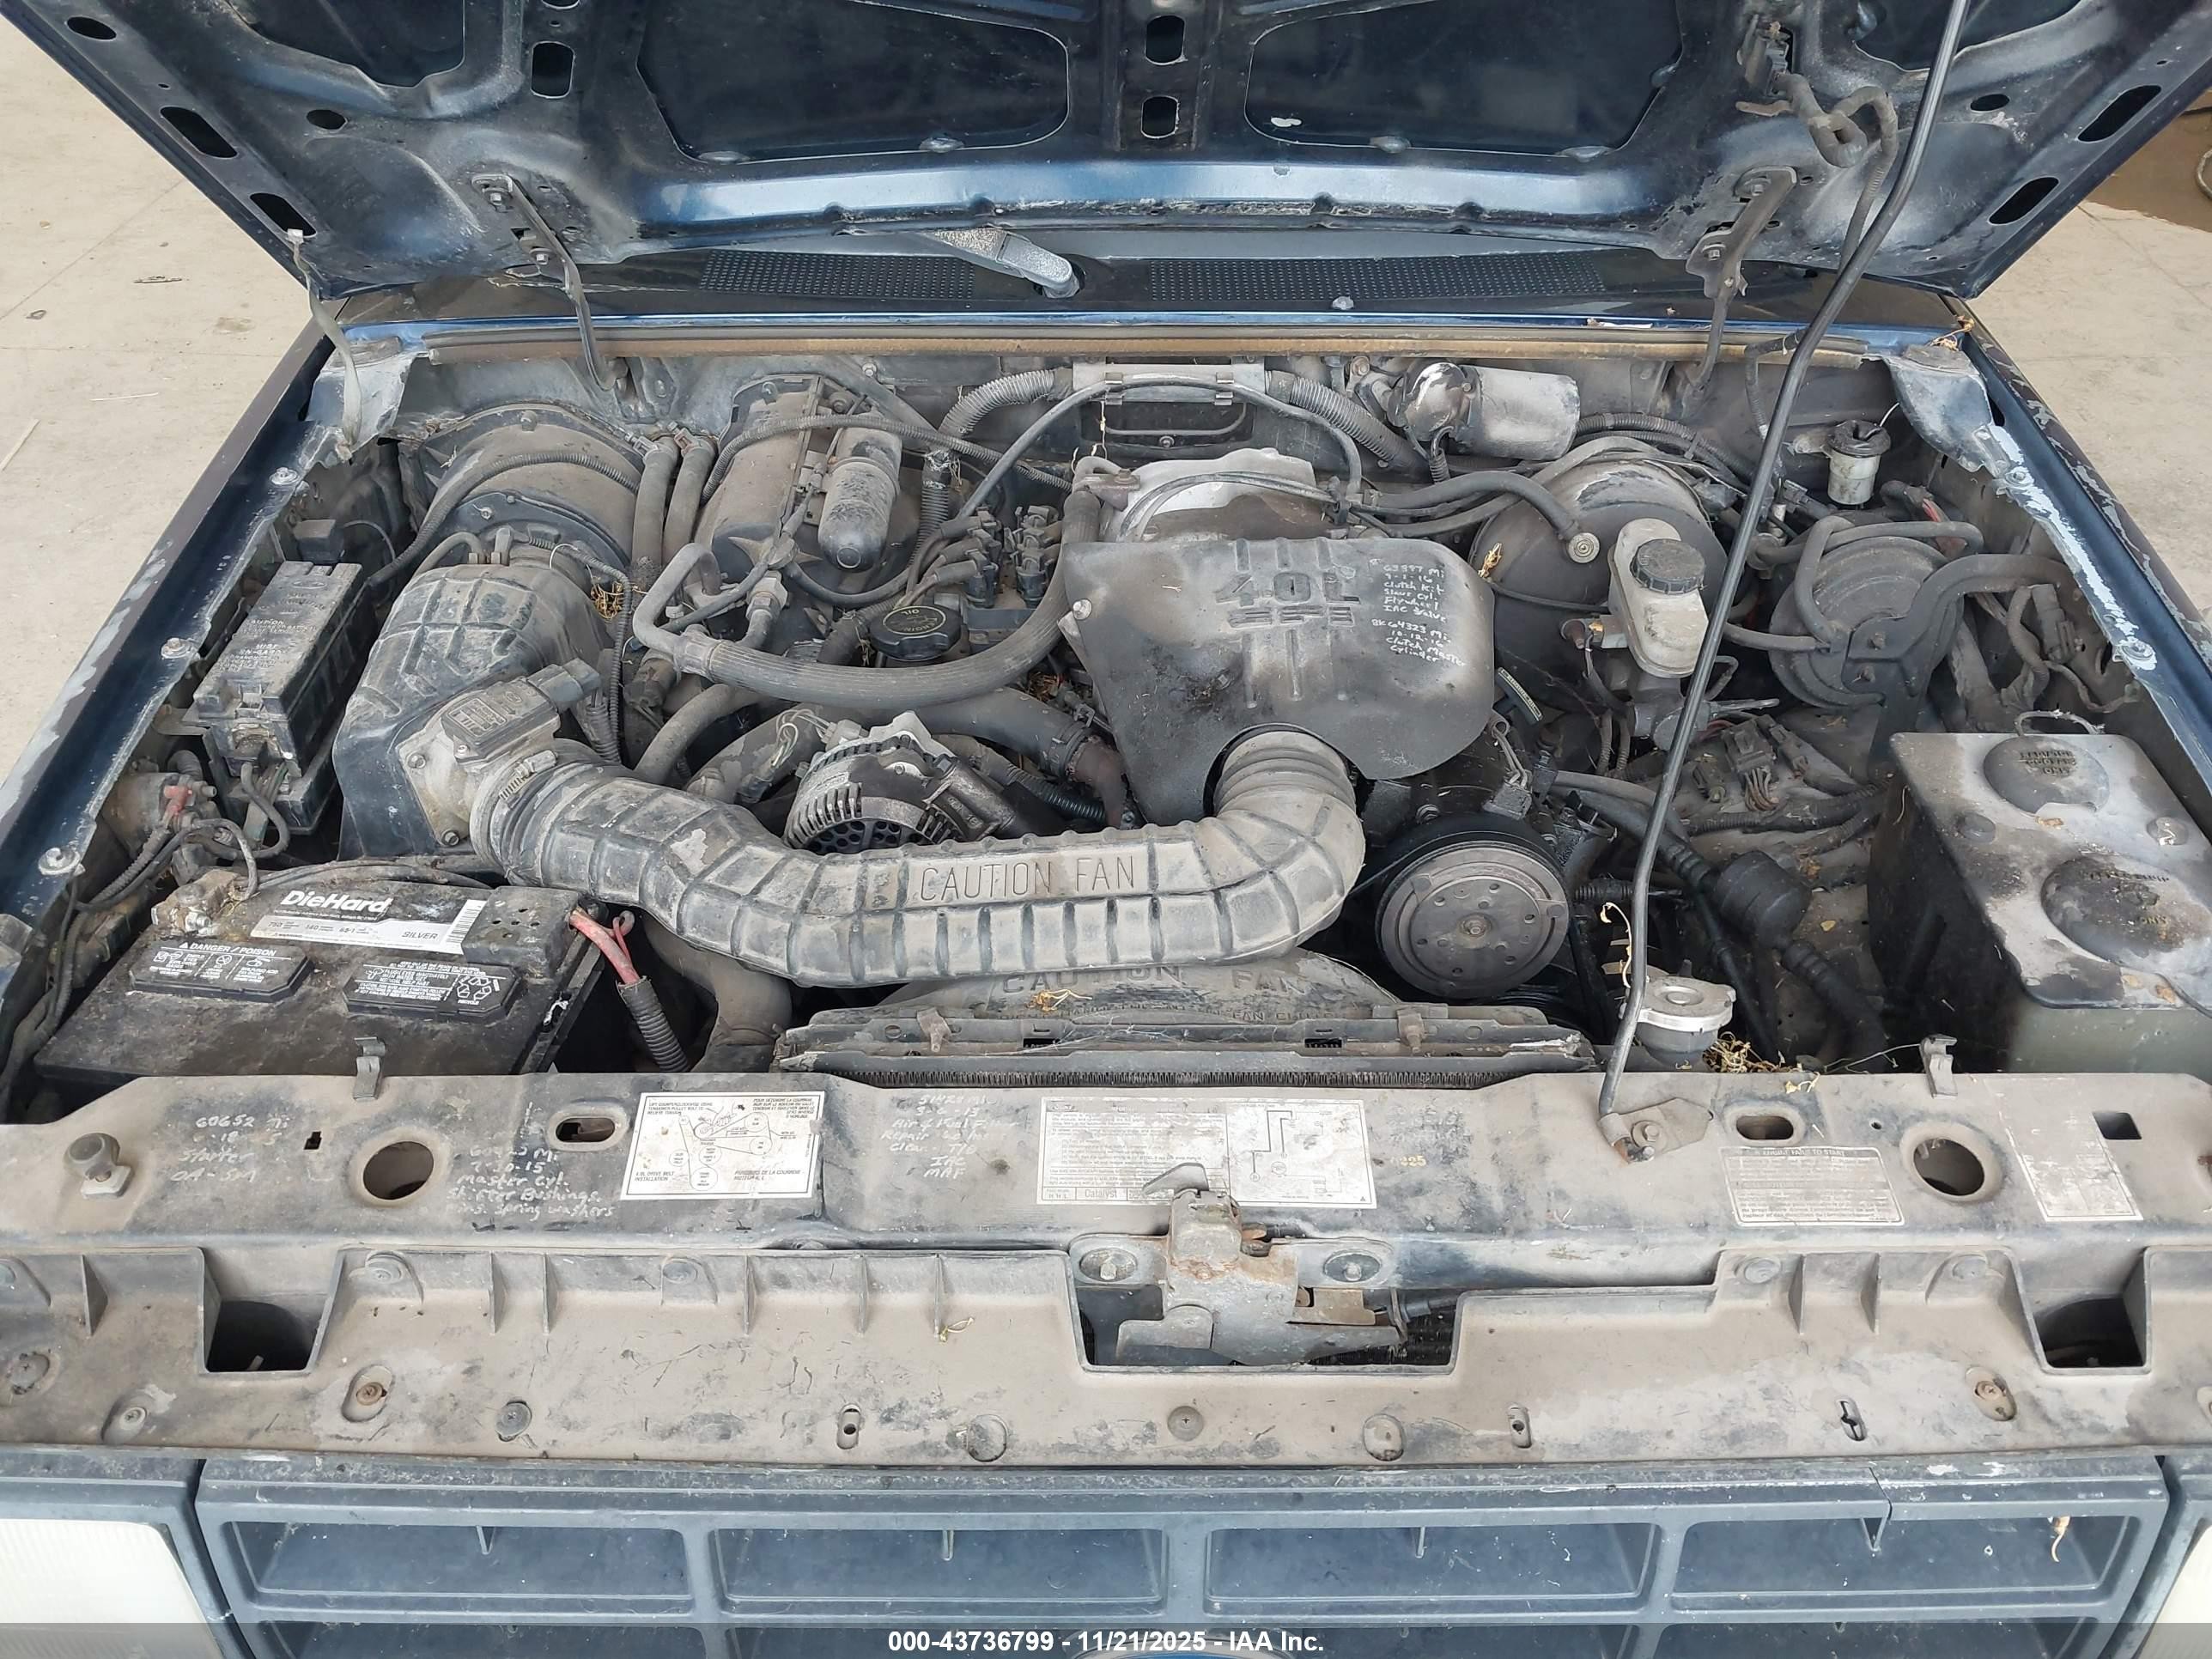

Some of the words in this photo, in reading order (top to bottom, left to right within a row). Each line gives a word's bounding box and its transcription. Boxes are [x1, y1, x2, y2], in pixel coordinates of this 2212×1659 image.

[1421, 584, 1445, 595] Kit
[920, 860, 1052, 902] CAUTION
[1075, 855, 1135, 892] FAN
[279, 890, 394, 914] DieHard
[401, 931, 439, 941] SILVER
[189, 943, 231, 953] DANGER
[239, 947, 277, 957] POISON
[196, 1114, 256, 1128] 60652
[923, 1167, 967, 1180] MAF
[1085, 1188, 1119, 1200] Catalyst
